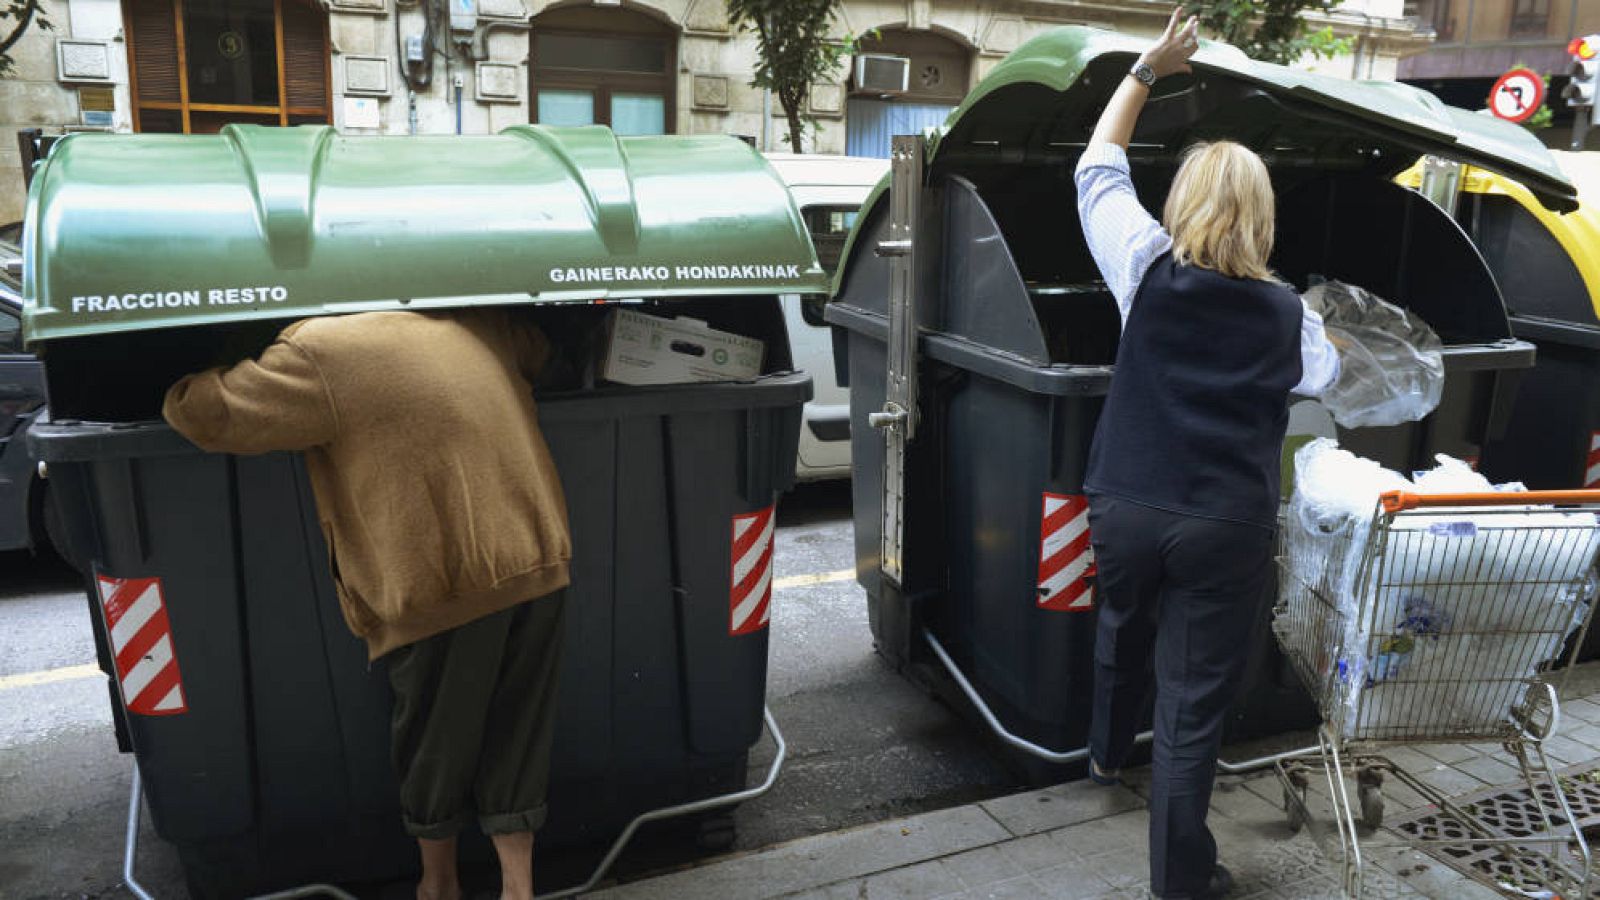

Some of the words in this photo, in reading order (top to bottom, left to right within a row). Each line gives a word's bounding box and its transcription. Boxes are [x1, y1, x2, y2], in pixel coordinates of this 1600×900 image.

[549, 266, 669, 282] GAINERAKO
[675, 264, 800, 280] HONDAKINAK
[72, 290, 200, 312] FRACCION
[208, 286, 288, 305] RESTO
